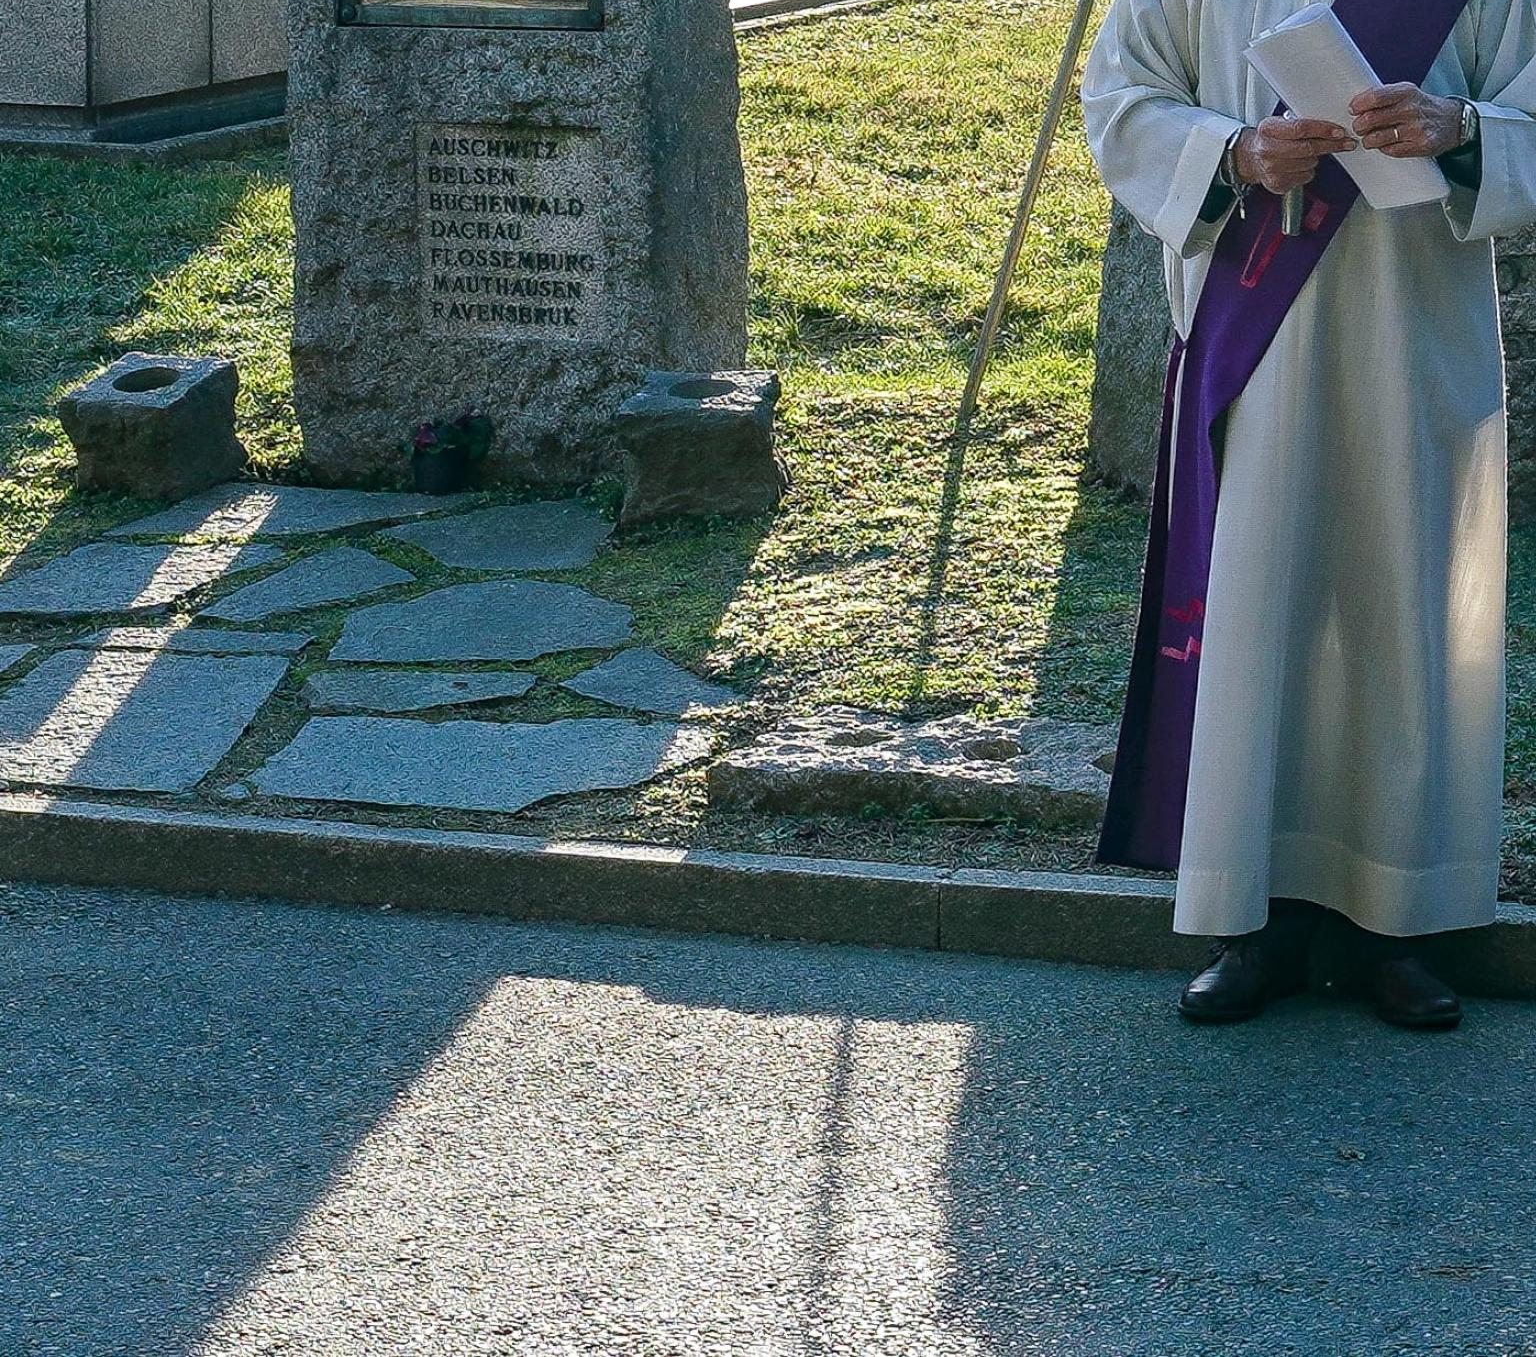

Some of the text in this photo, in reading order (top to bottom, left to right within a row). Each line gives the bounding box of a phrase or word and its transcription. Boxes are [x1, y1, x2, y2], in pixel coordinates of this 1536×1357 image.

[428, 138, 560, 160] AUSCHWITZ
[428, 166, 516, 186] BELSEN
[429, 194, 585, 217] BUCHENWALD
[430, 220, 522, 241] DACHAU
[432, 275, 583, 299] MAUTHAUSEN
[432, 300, 579, 327] RAVENSBRUK
